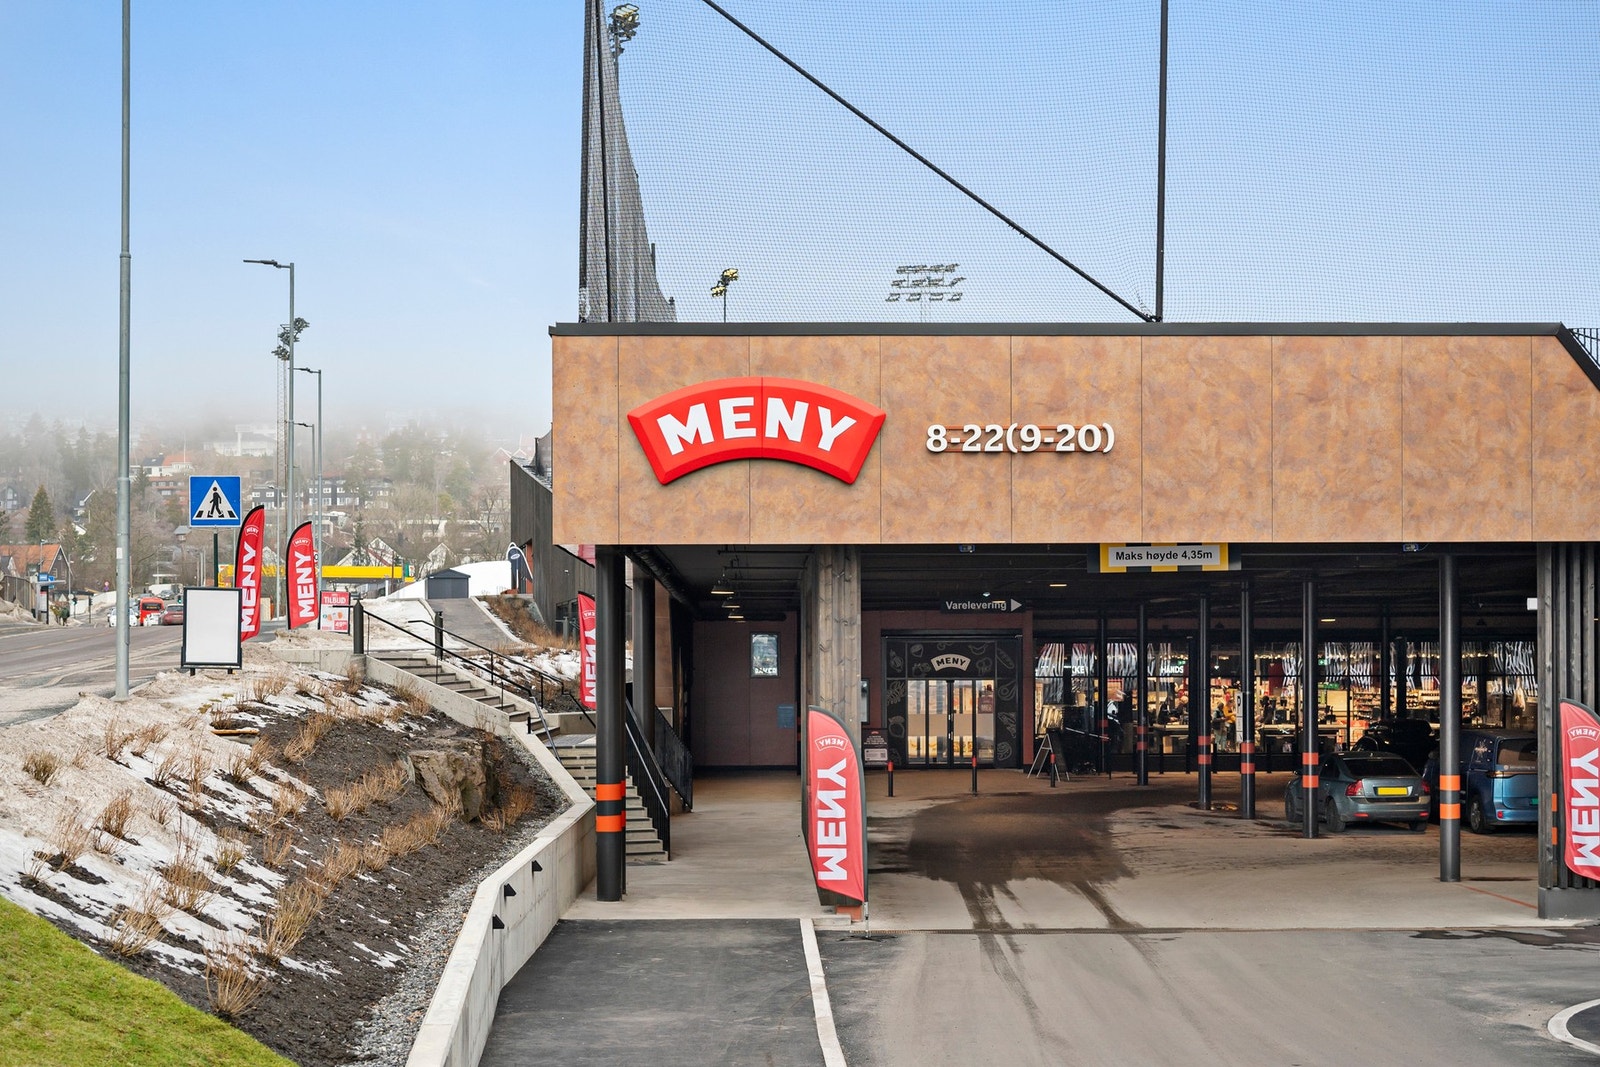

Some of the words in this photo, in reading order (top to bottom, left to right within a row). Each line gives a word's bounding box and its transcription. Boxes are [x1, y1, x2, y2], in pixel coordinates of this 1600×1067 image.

[656, 396, 857, 456] MENY
[925, 423, 1115, 454] 8-22(9-20)
[1115, 551, 1143, 561] Maks
[1146, 551, 1178, 562] høyde
[1181, 550, 1213, 560] 4,35m
[241, 541, 256, 632] MENY
[295, 551, 315, 618] MENY
[324, 596, 347, 604] TILBUD
[945, 600, 1007, 611] Varelevering
[935, 657, 966, 667] MENY
